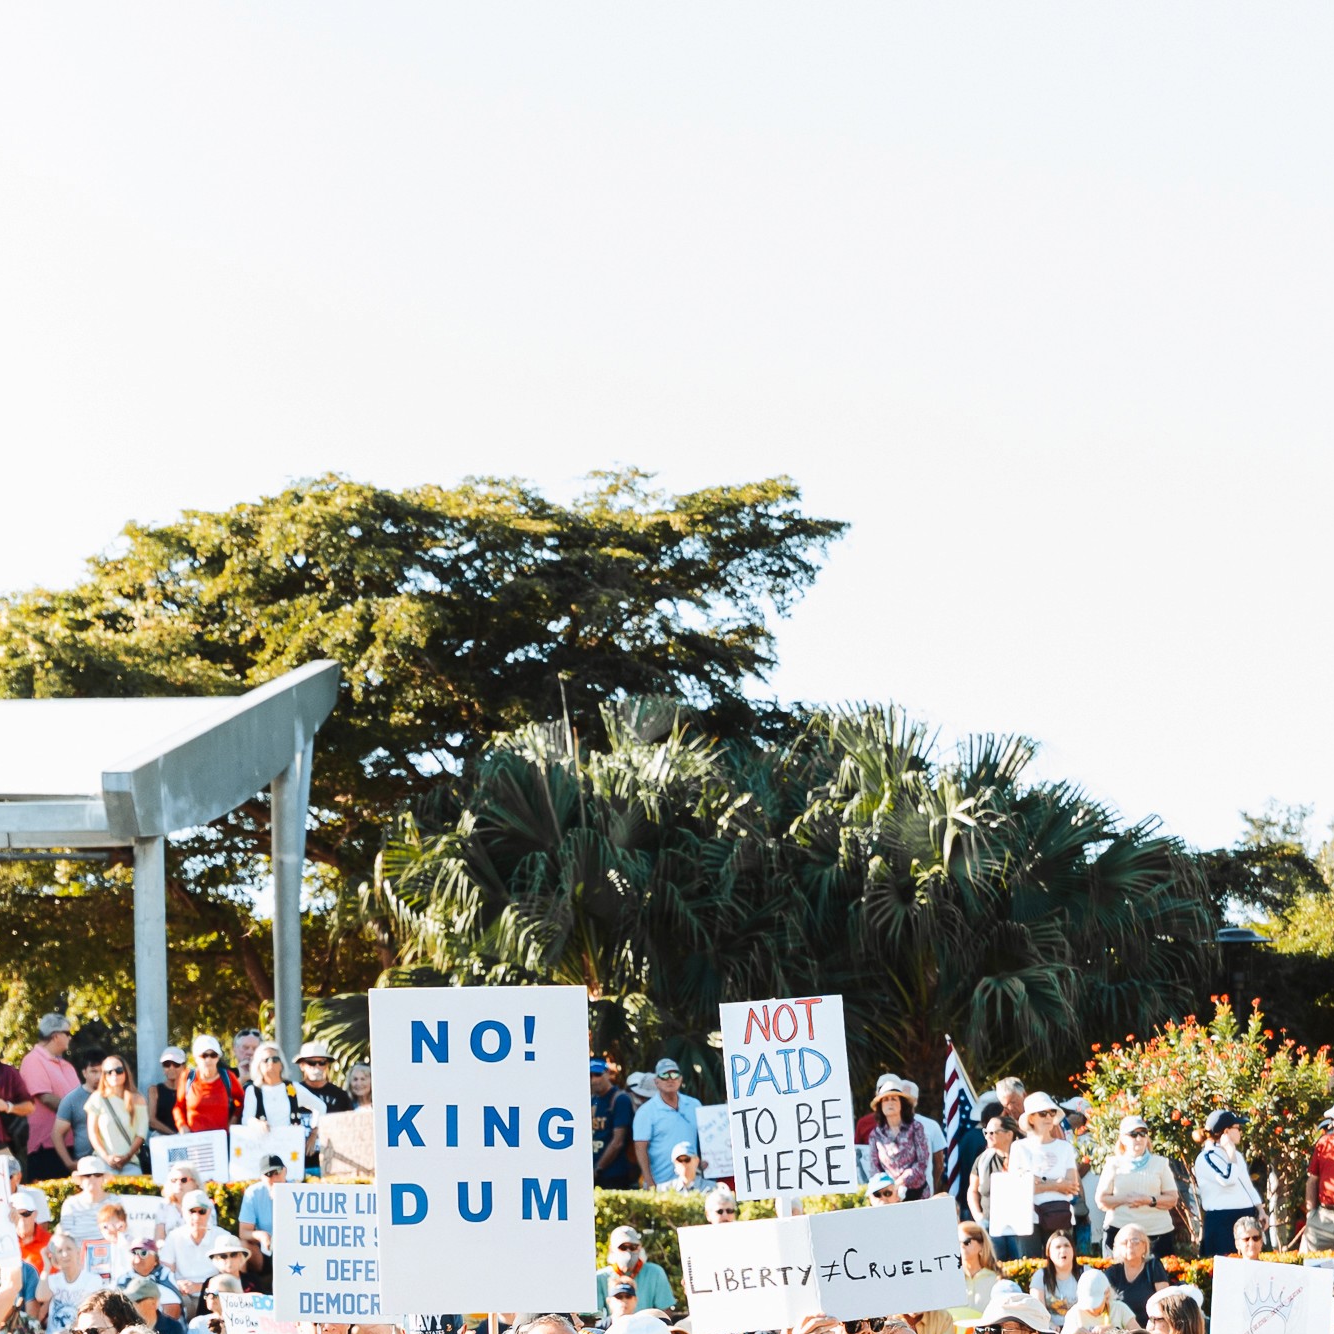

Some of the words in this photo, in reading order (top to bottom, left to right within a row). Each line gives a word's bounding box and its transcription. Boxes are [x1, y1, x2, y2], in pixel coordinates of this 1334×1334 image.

[410, 1015, 536, 1063] NO!
[744, 998, 822, 1044] NOT
[730, 1047, 832, 1099] PAID
[386, 1104, 574, 1150] KING
[732, 1107, 777, 1149] TO
[796, 1098, 843, 1144] BE
[744, 1145, 850, 1192] HERE
[292, 1192, 347, 1214] YOUR
[390, 1178, 568, 1225] DUM
[299, 1225, 366, 1247] UNDER
[326, 1259, 379, 1282] DEFE
[688, 1256, 813, 1293] LIBERTY
[252, 1295, 273, 1311] BO
